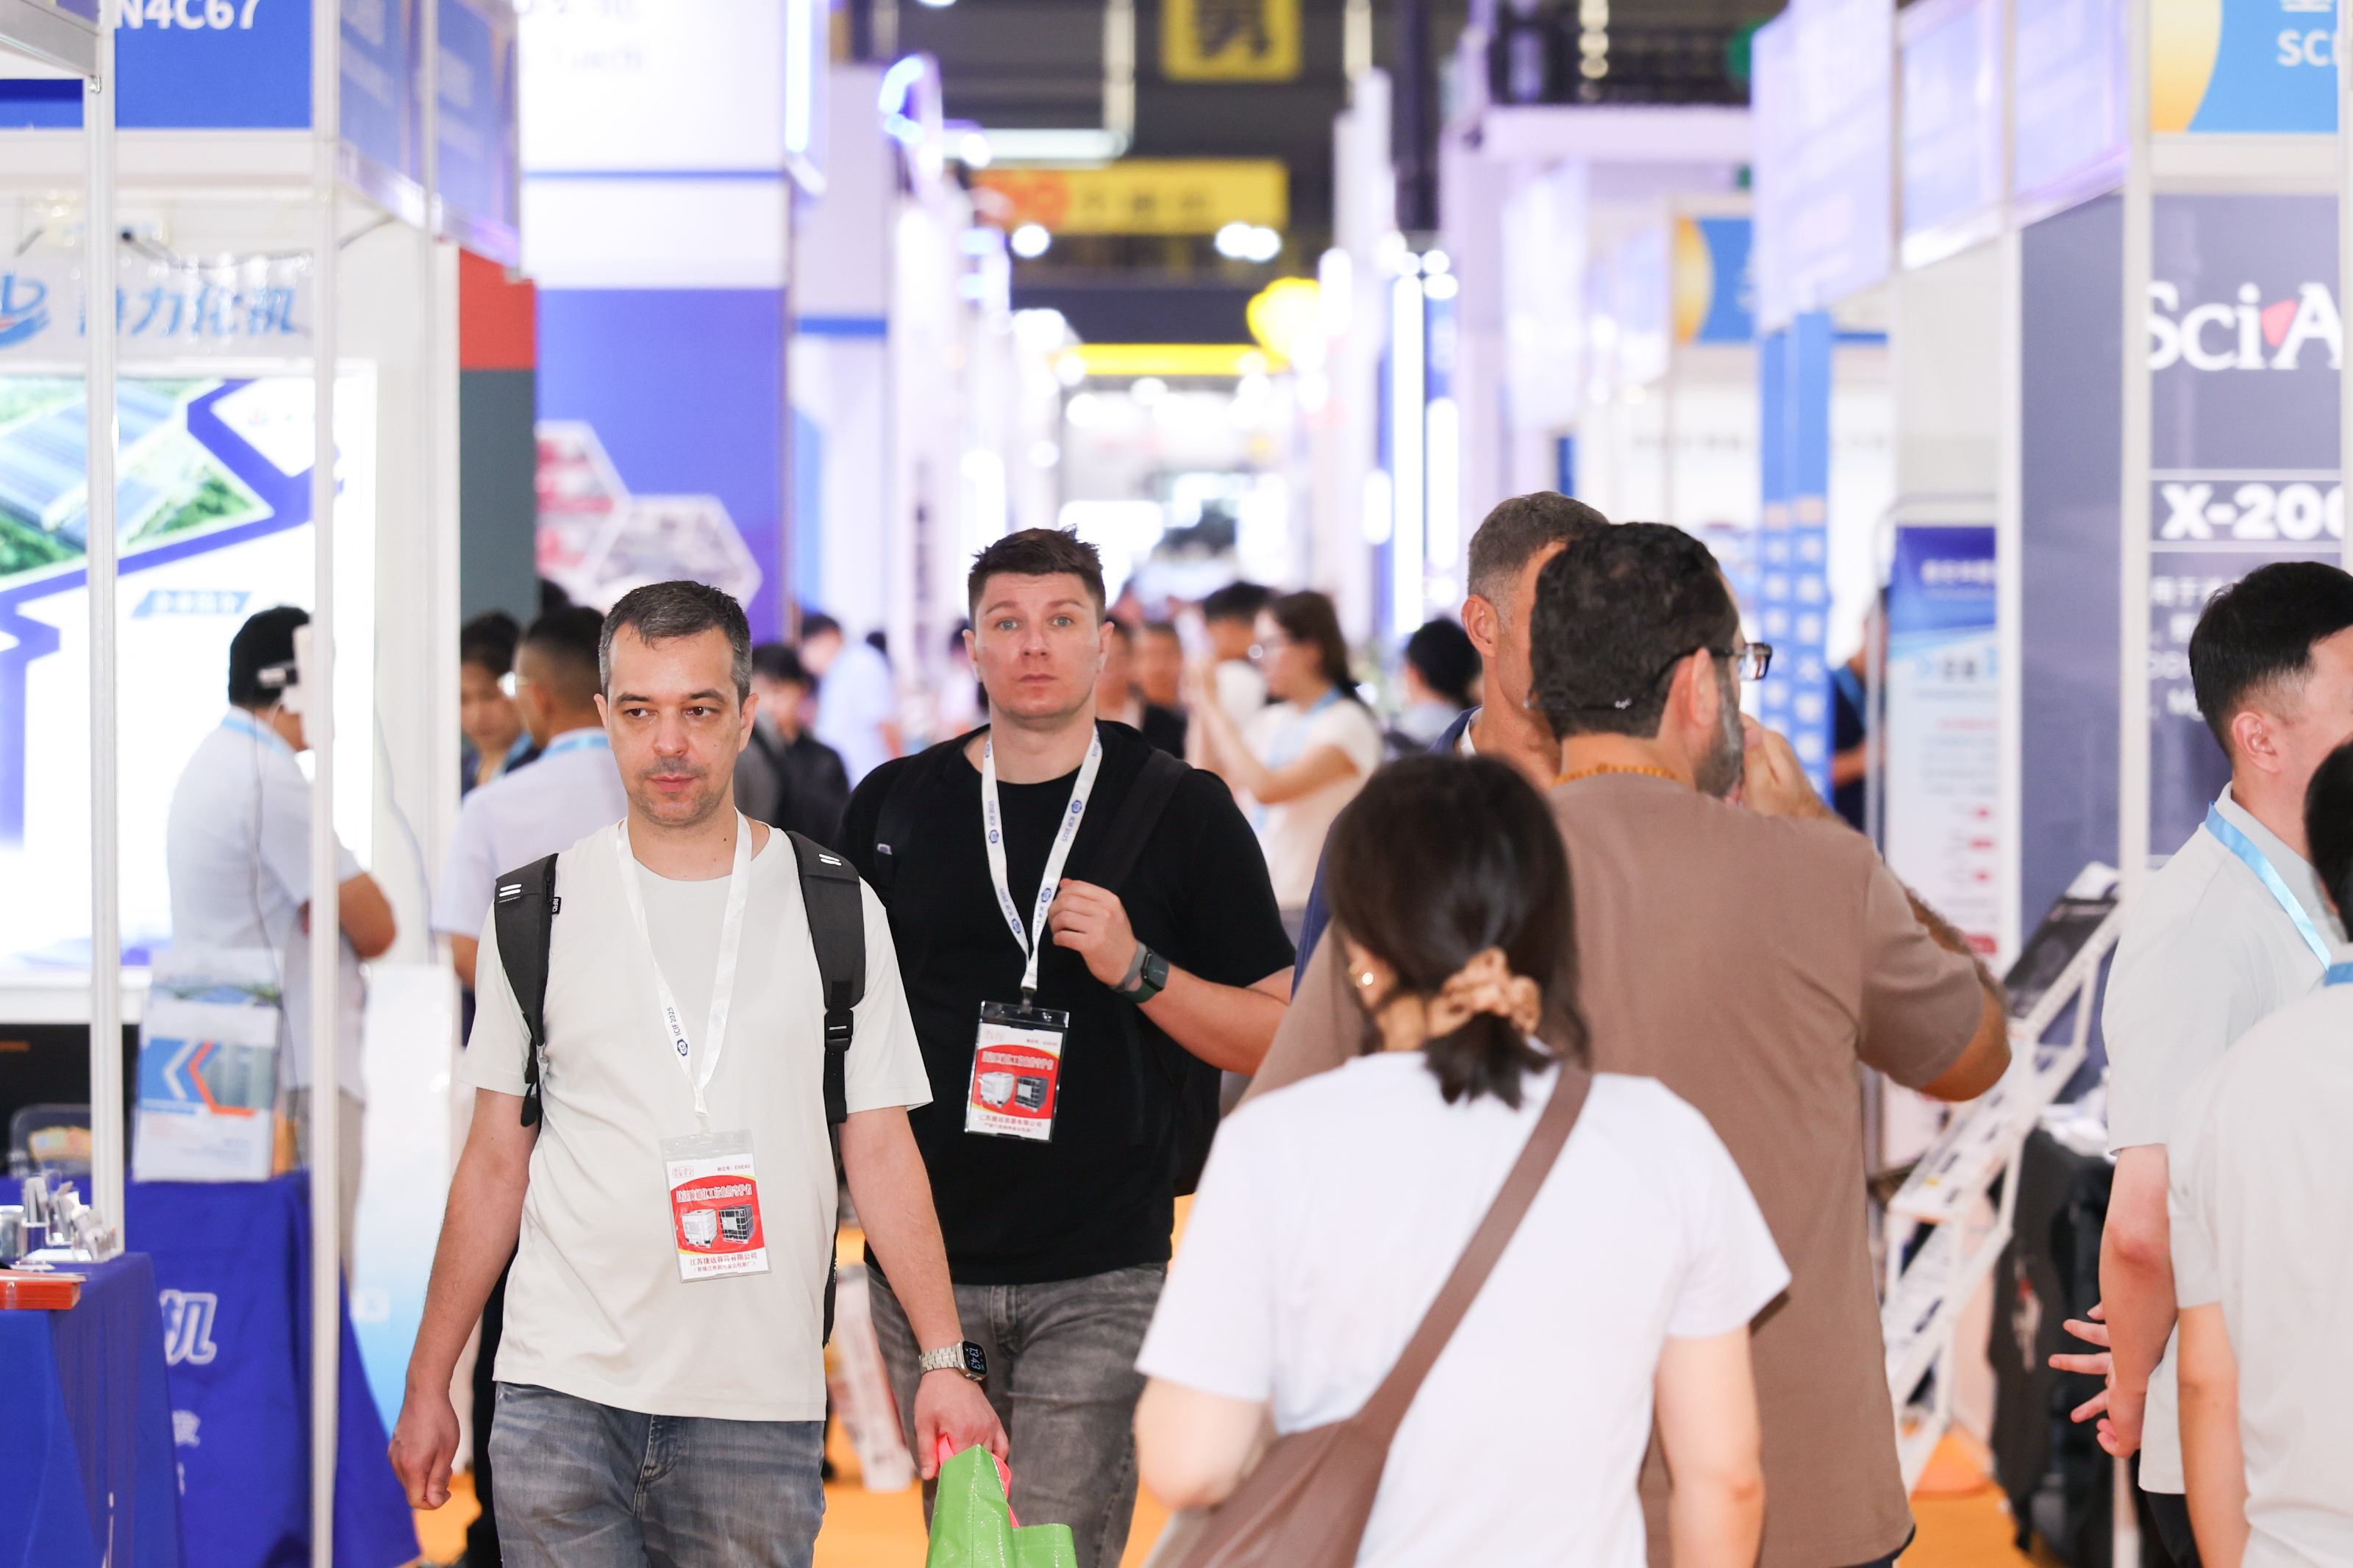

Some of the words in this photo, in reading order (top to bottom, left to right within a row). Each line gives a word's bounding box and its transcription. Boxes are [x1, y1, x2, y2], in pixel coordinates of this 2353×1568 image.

[76, 284, 297, 337] 力化机
[667, 1006, 677, 1023] 2025
[672, 1024, 682, 1037] ICIF
